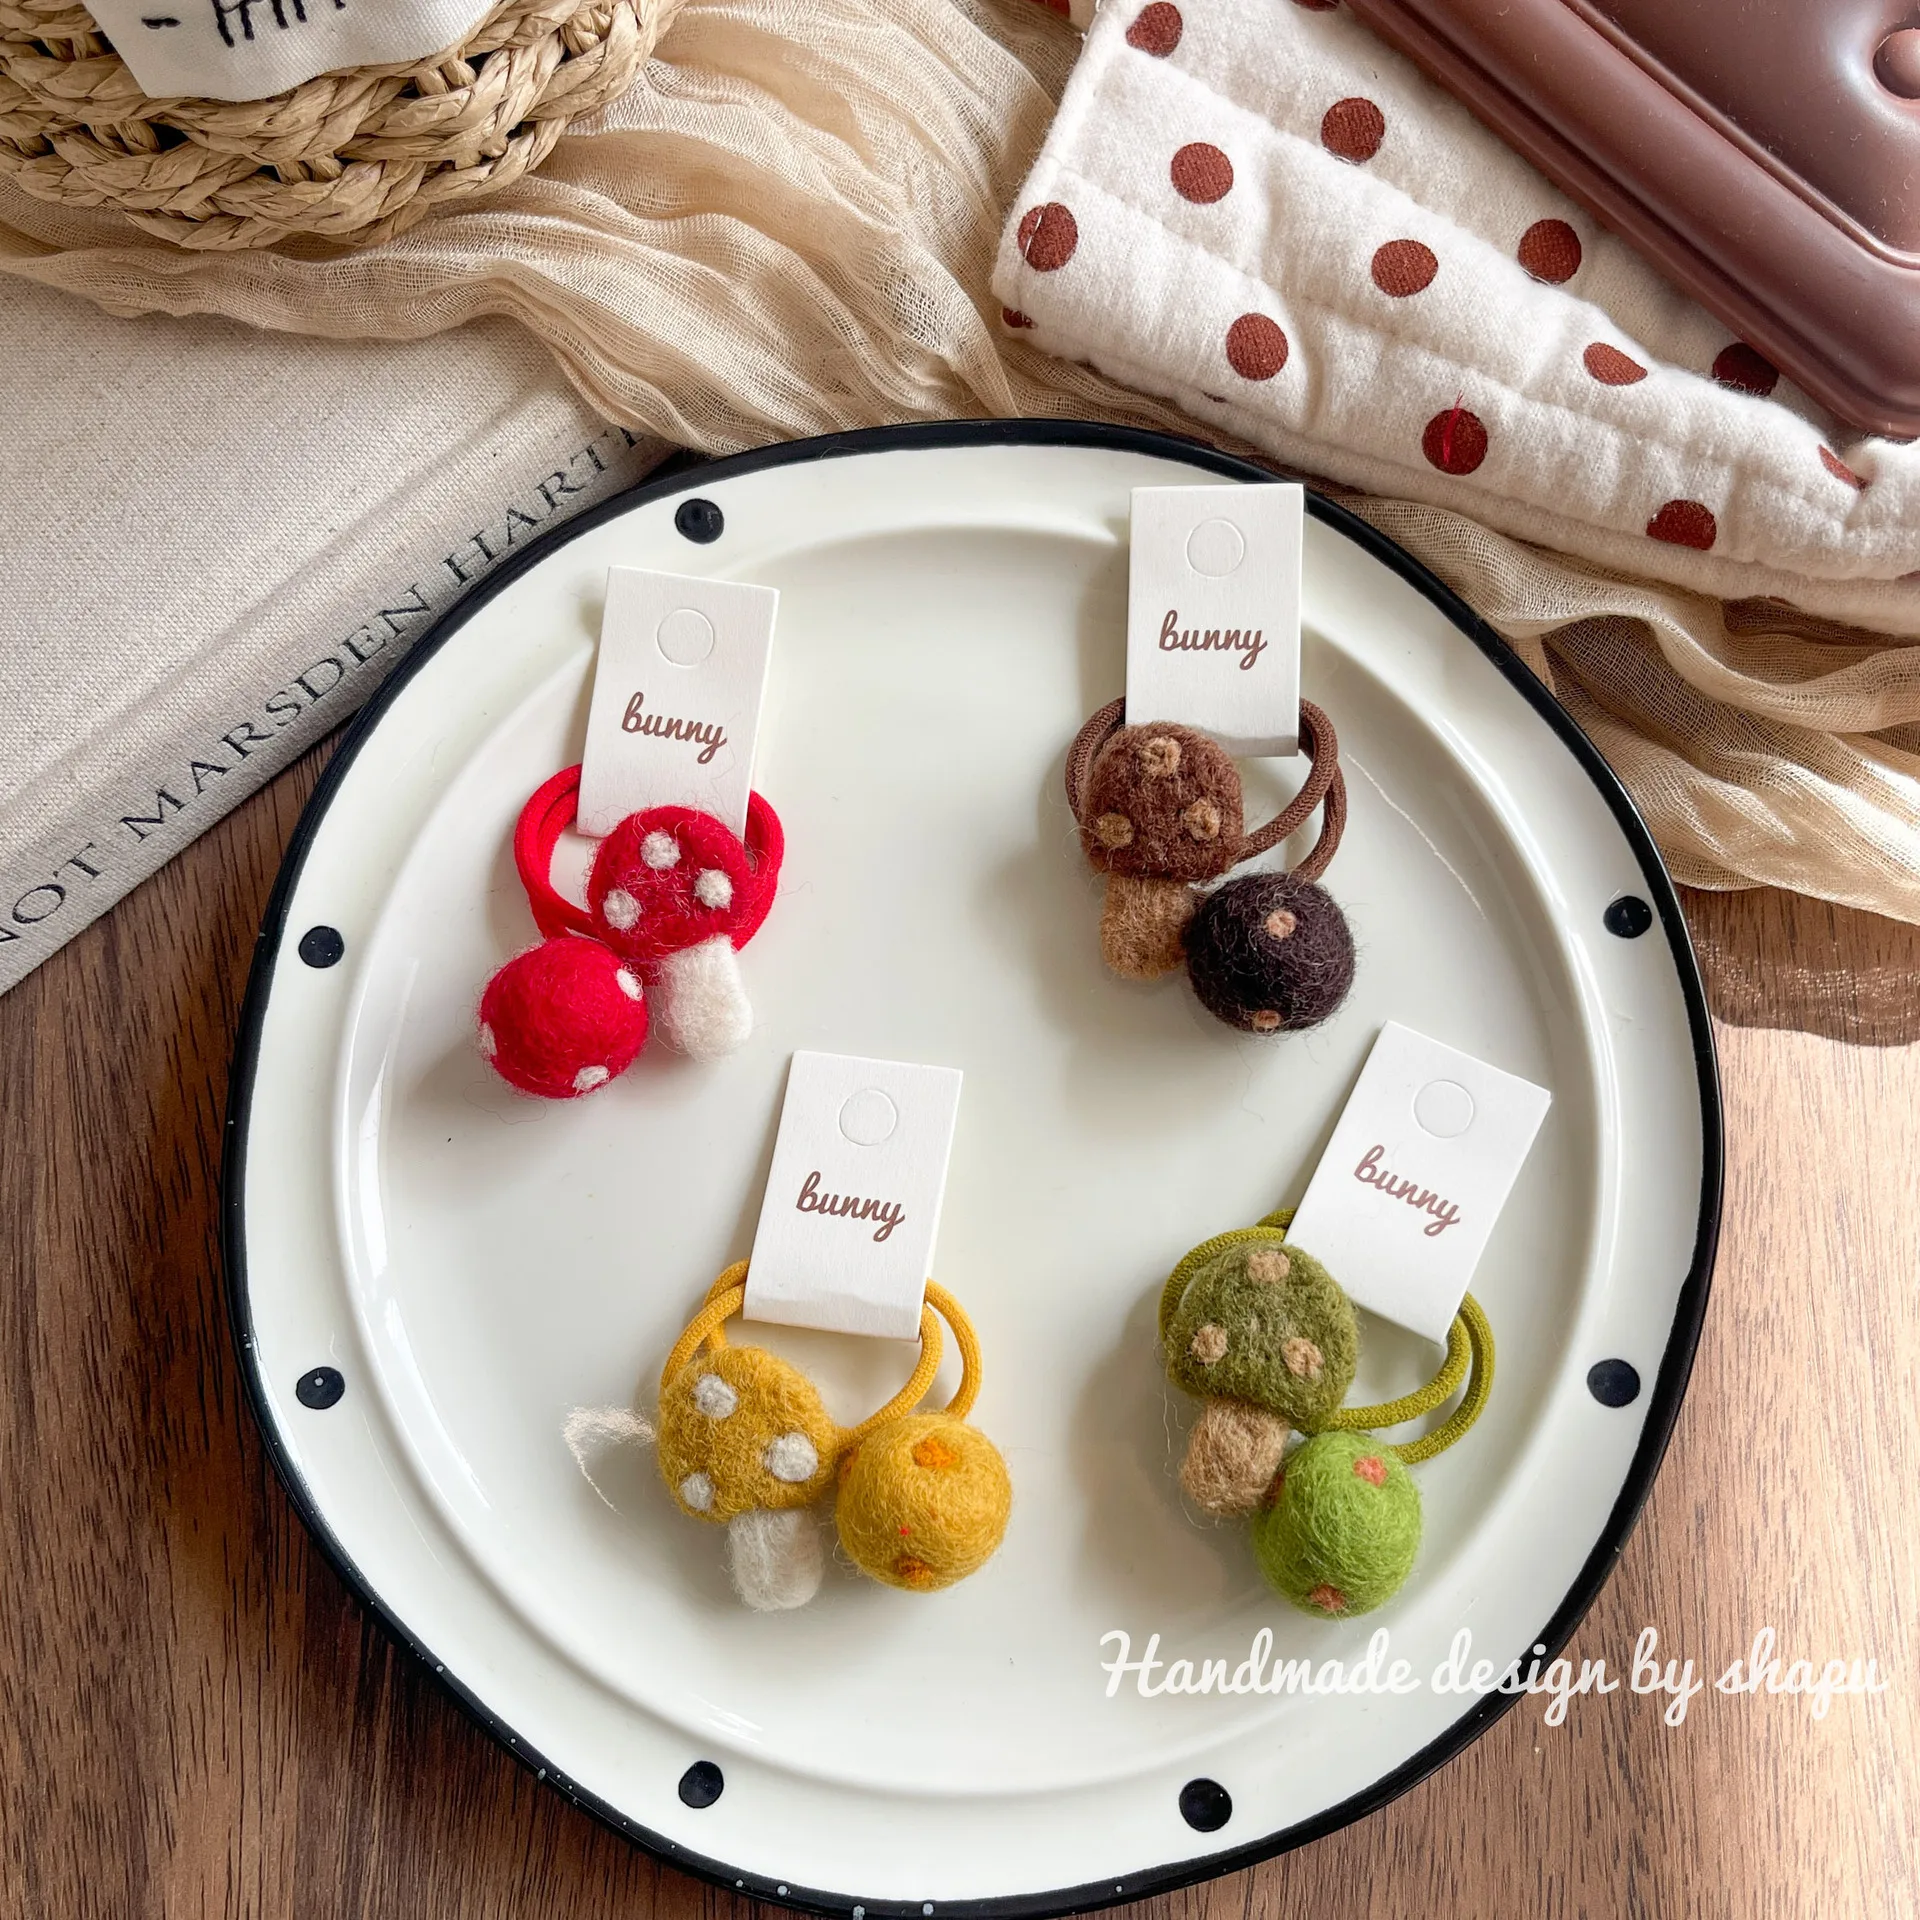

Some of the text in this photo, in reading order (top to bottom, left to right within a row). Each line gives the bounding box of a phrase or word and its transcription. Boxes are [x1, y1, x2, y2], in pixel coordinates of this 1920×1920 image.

[1158, 609, 1268, 671] bunny
[119, 583, 432, 843] MARSDEN
[621, 691, 728, 765] bunny
[795, 1170, 906, 1243] bunny
[1353, 1144, 1461, 1237] bunny
